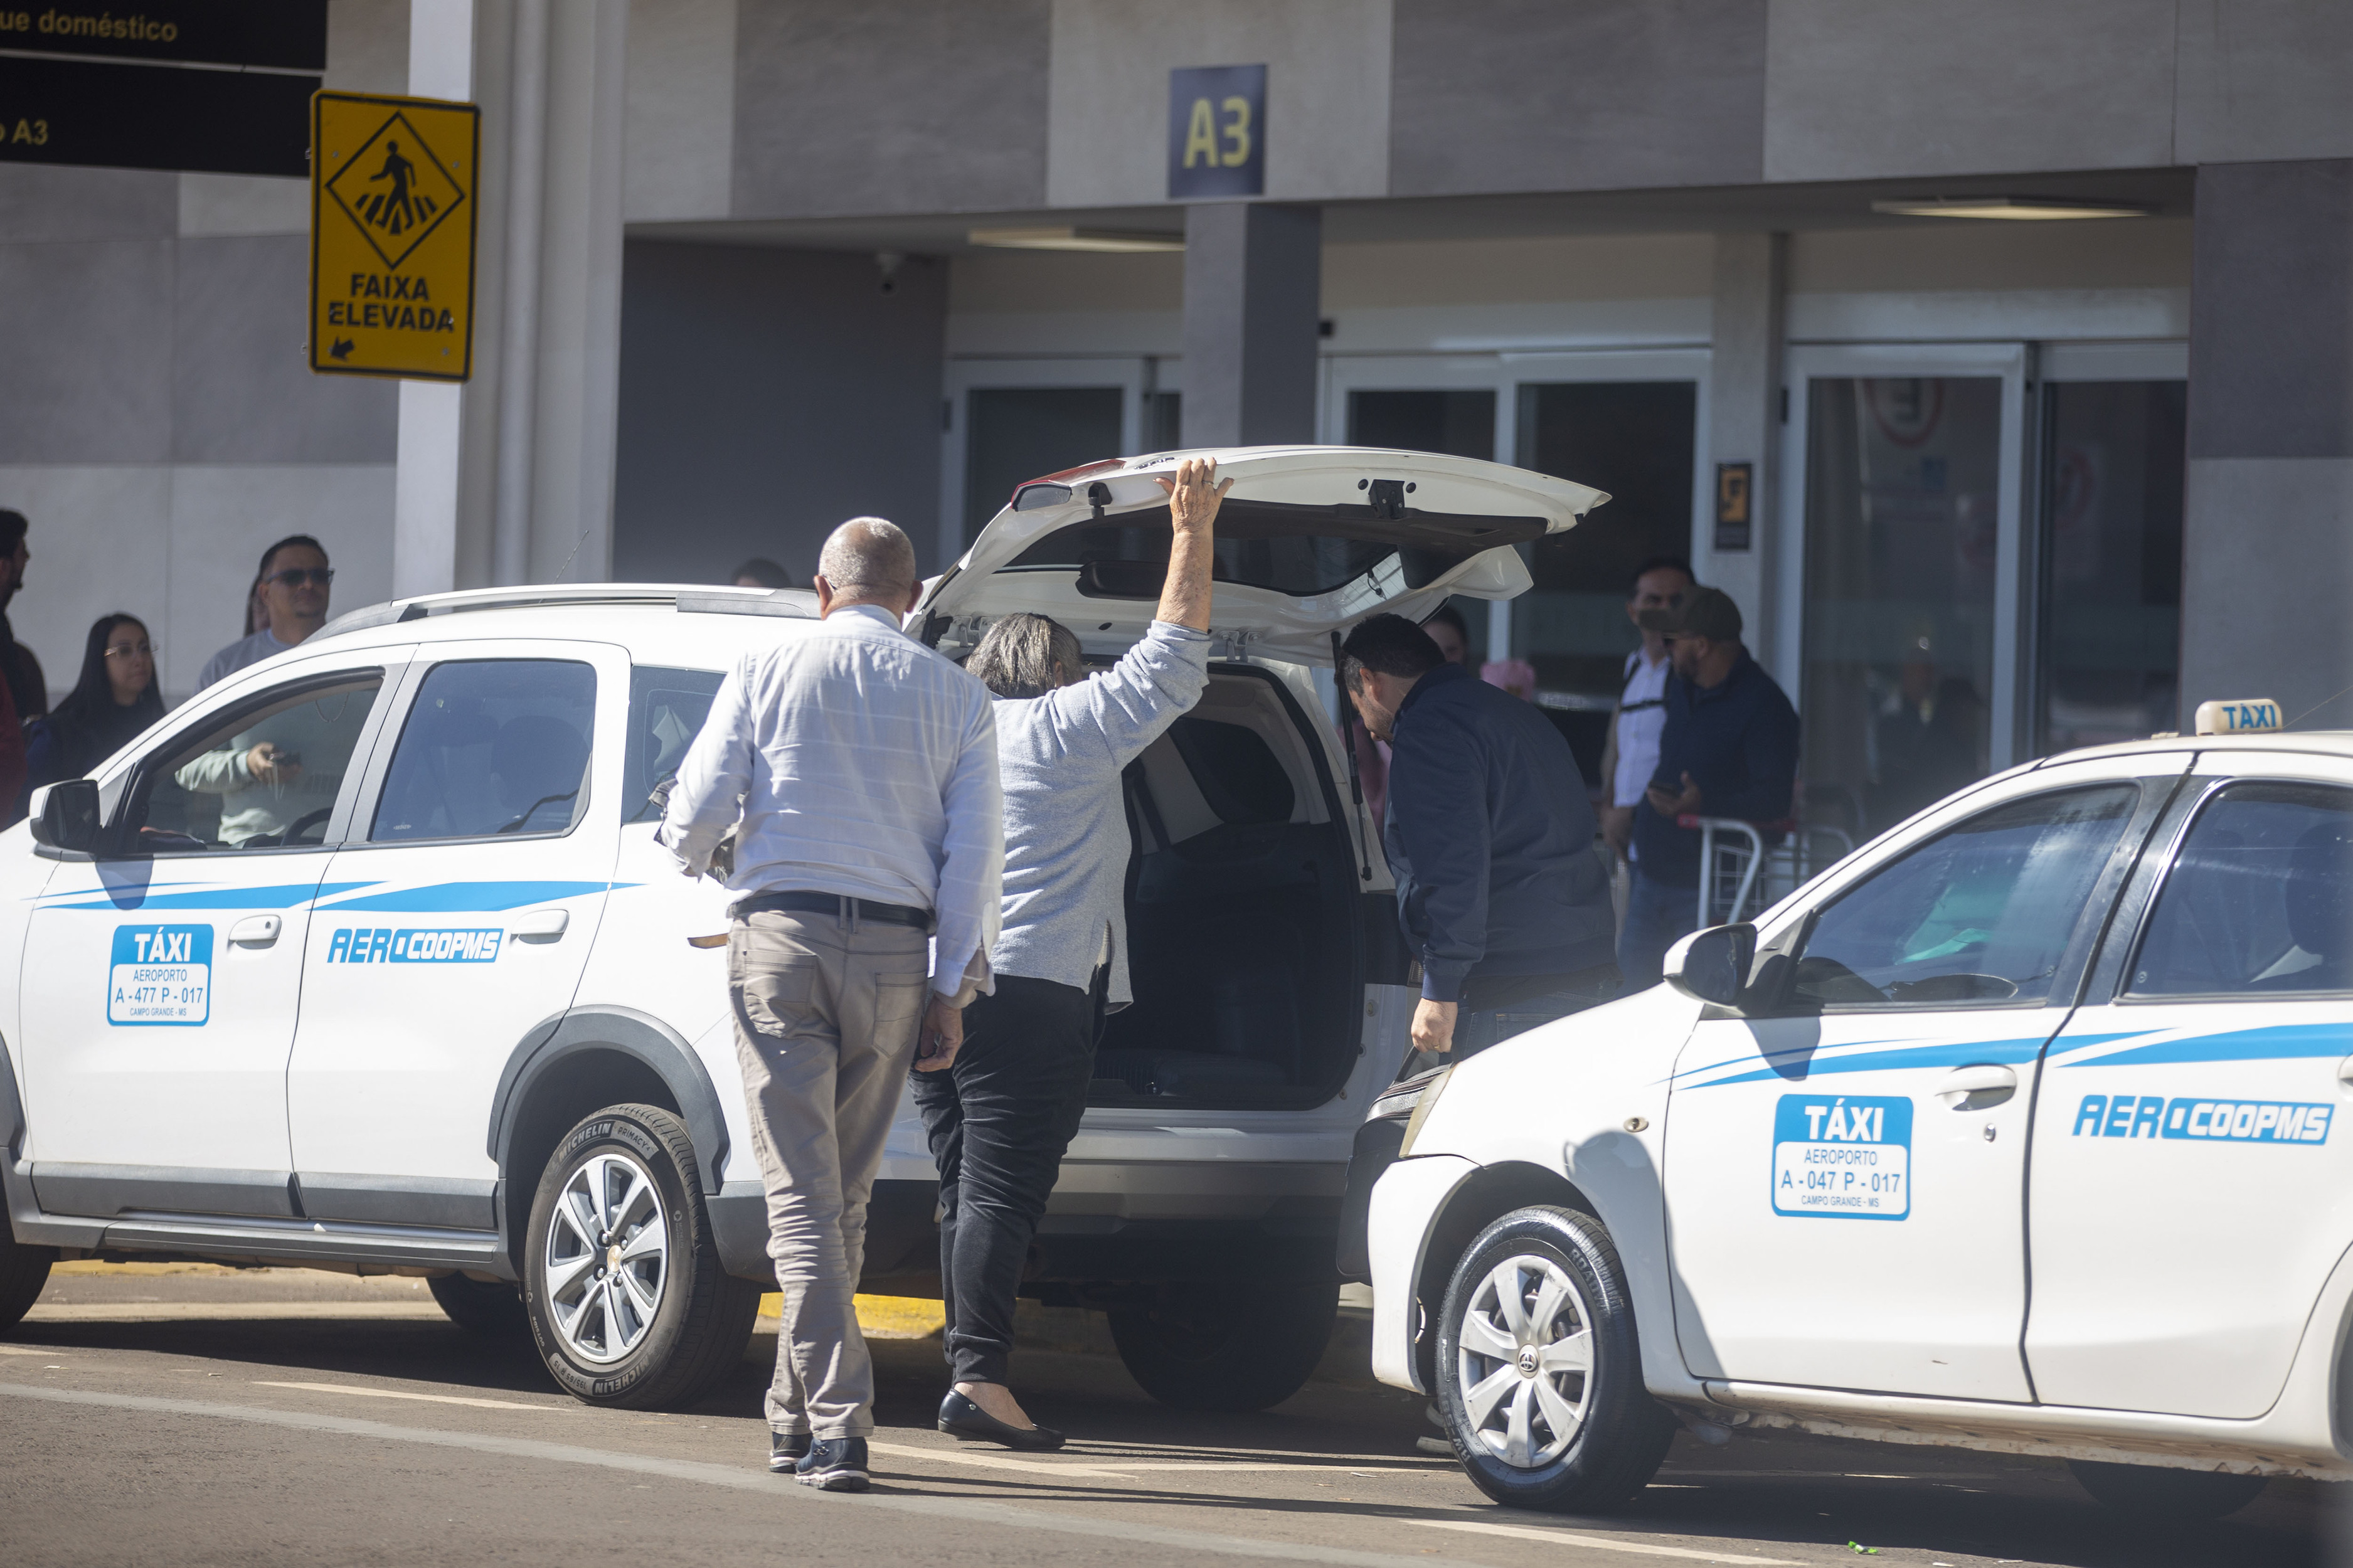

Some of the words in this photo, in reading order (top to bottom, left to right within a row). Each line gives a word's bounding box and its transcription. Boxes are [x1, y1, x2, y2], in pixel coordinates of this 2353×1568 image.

[38, 8, 178, 42] doméstico
[11, 118, 48, 146] A3
[1183, 97, 1251, 169] A3
[351, 273, 429, 301] FAIXA
[328, 302, 454, 333] ELEVADA
[134, 926, 192, 962] TÁXI
[327, 928, 504, 963] AEROCOOPMS
[133, 969, 188, 982] AEROPORTO
[181, 987, 203, 1003] 017
[130, 1007, 150, 1016] CAMPO
[151, 1007, 174, 1016] GRANDE
[179, 1007, 186, 1016] MS
[1804, 1098, 1884, 1142] TÁXI
[2072, 1094, 2335, 1145] AEROCOOPMS
[559, 1123, 612, 1161] MICHELIN
[617, 1126, 649, 1148] PRIMACY
[1804, 1149, 1878, 1165] AEROPORTO
[1871, 1173, 1900, 1192] 017
[1802, 1195, 1828, 1205] CAMPO
[1830, 1197, 1861, 1207] GRANDE
[1868, 1198, 1879, 1207] MS
[533, 1316, 545, 1347] OUTSIDE
[566, 1375, 587, 1390] 195/65
[595, 1355, 649, 1394] MICHELIN
